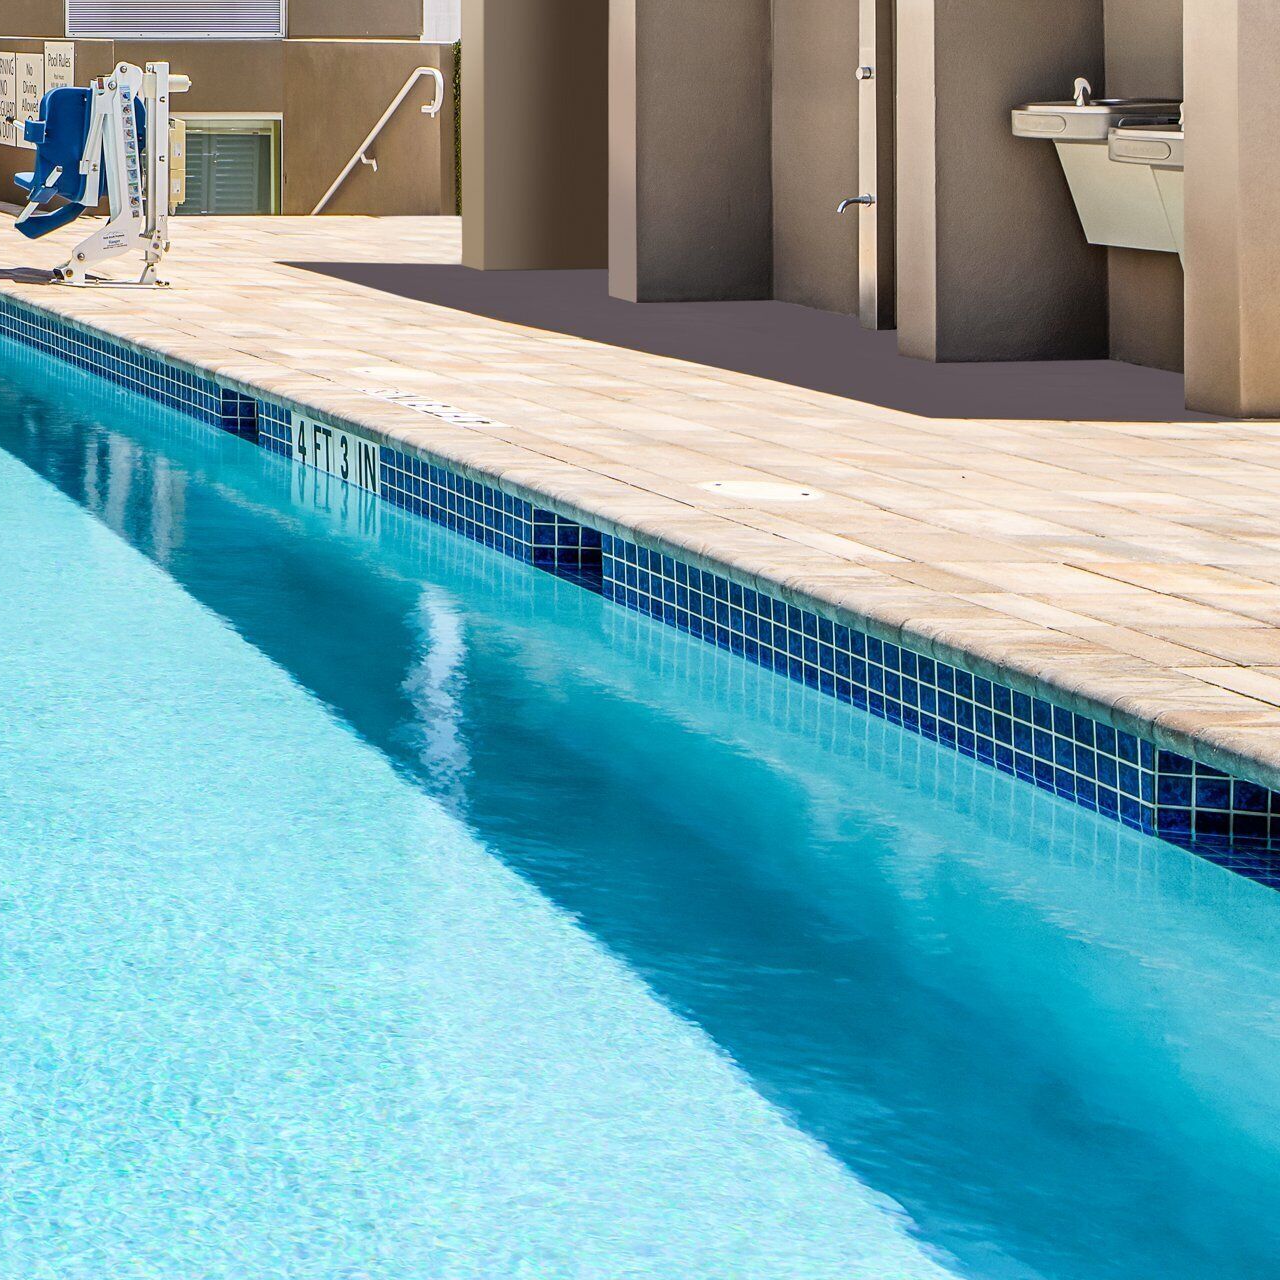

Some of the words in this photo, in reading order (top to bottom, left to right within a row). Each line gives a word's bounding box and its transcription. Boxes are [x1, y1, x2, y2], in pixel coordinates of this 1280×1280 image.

[48, 53, 57, 67] Pool
[58, 53, 71, 68] Rules
[26, 63, 33, 76] No
[0, 79, 7, 95] NO
[23, 80, 37, 98] Diving
[22, 98, 39, 112] Allowed
[3, 122, 14, 139] DUTY
[298, 421, 307, 464] 4
[313, 425, 332, 472] FT
[341, 435, 349, 479] 3
[358, 441, 377, 492] IN
